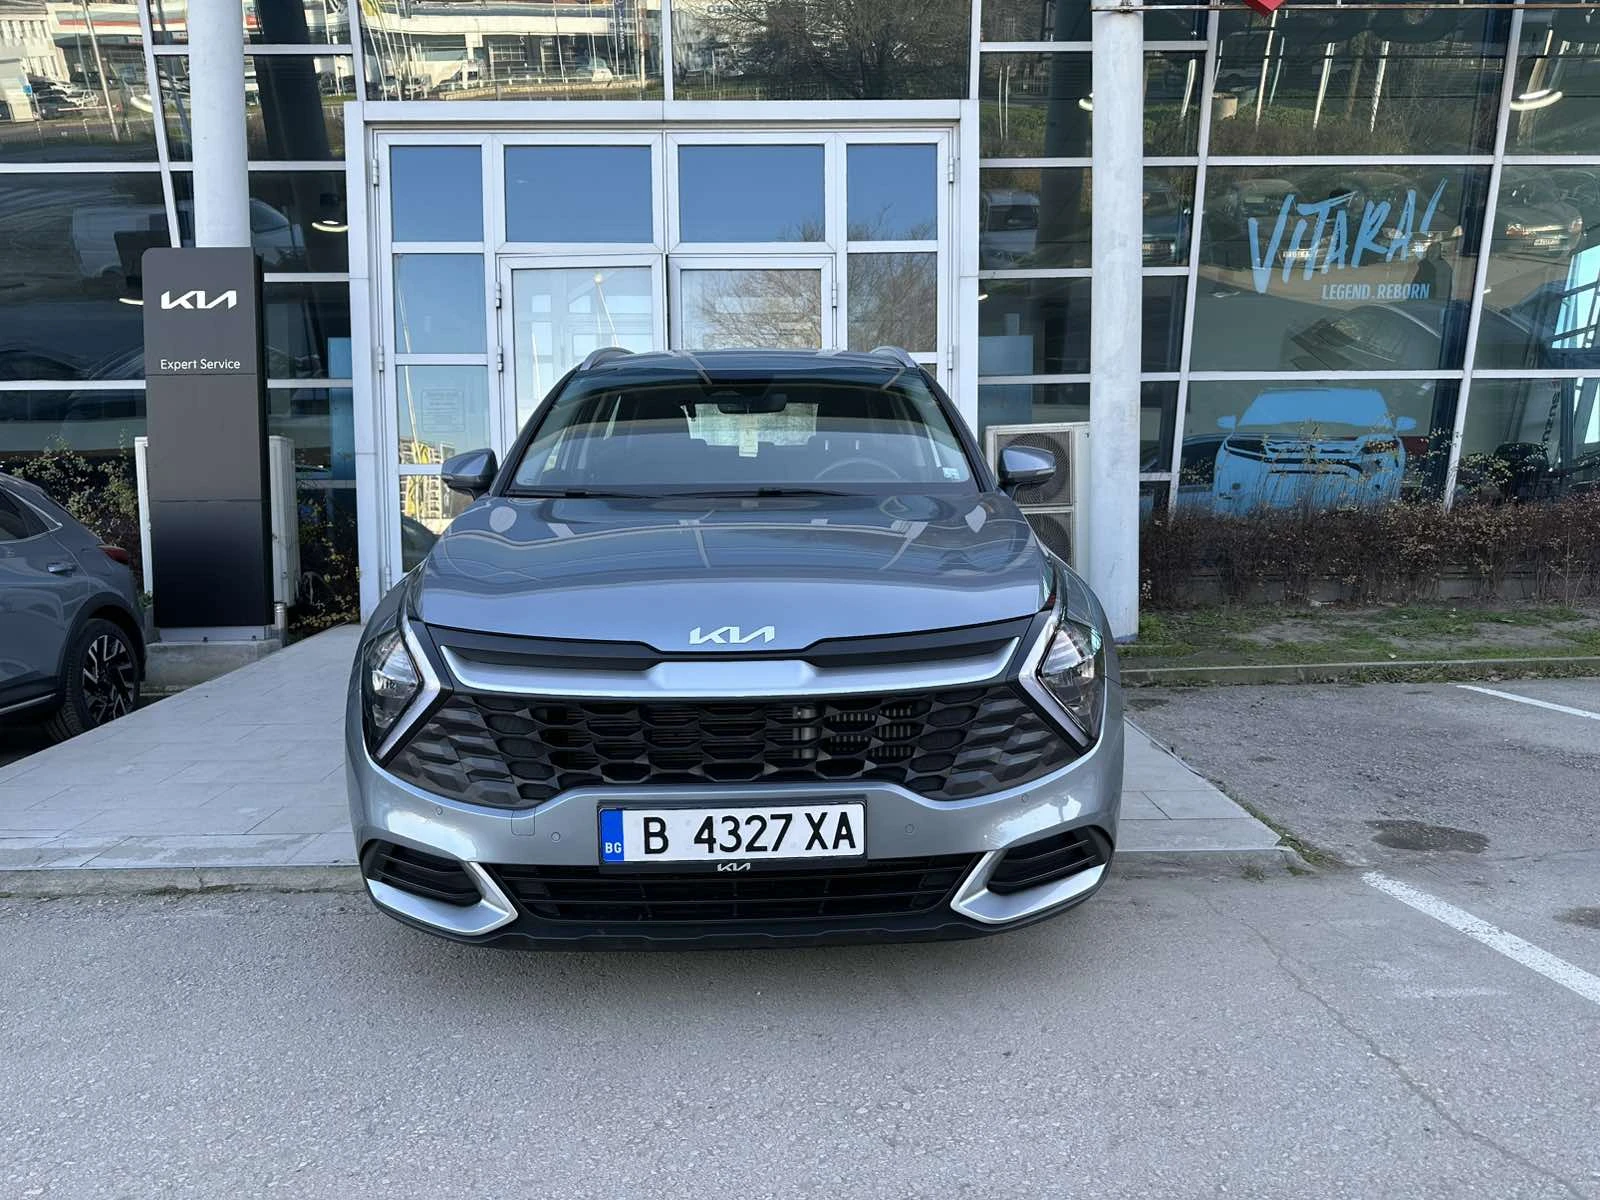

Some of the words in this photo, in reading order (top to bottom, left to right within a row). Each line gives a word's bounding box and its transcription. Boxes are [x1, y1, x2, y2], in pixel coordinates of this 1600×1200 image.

[161, 290, 237, 309] KIA
[1377, 283, 1430, 300] REBORN
[160, 359, 197, 371] Expert
[200, 358, 241, 370] Service
[689, 626, 775, 645] KIA
[643, 816, 669, 855] B
[693, 813, 793, 854] 4327
[804, 811, 857, 851] XA
[605, 842, 622, 854] BG
[717, 863, 750, 872] KIA
